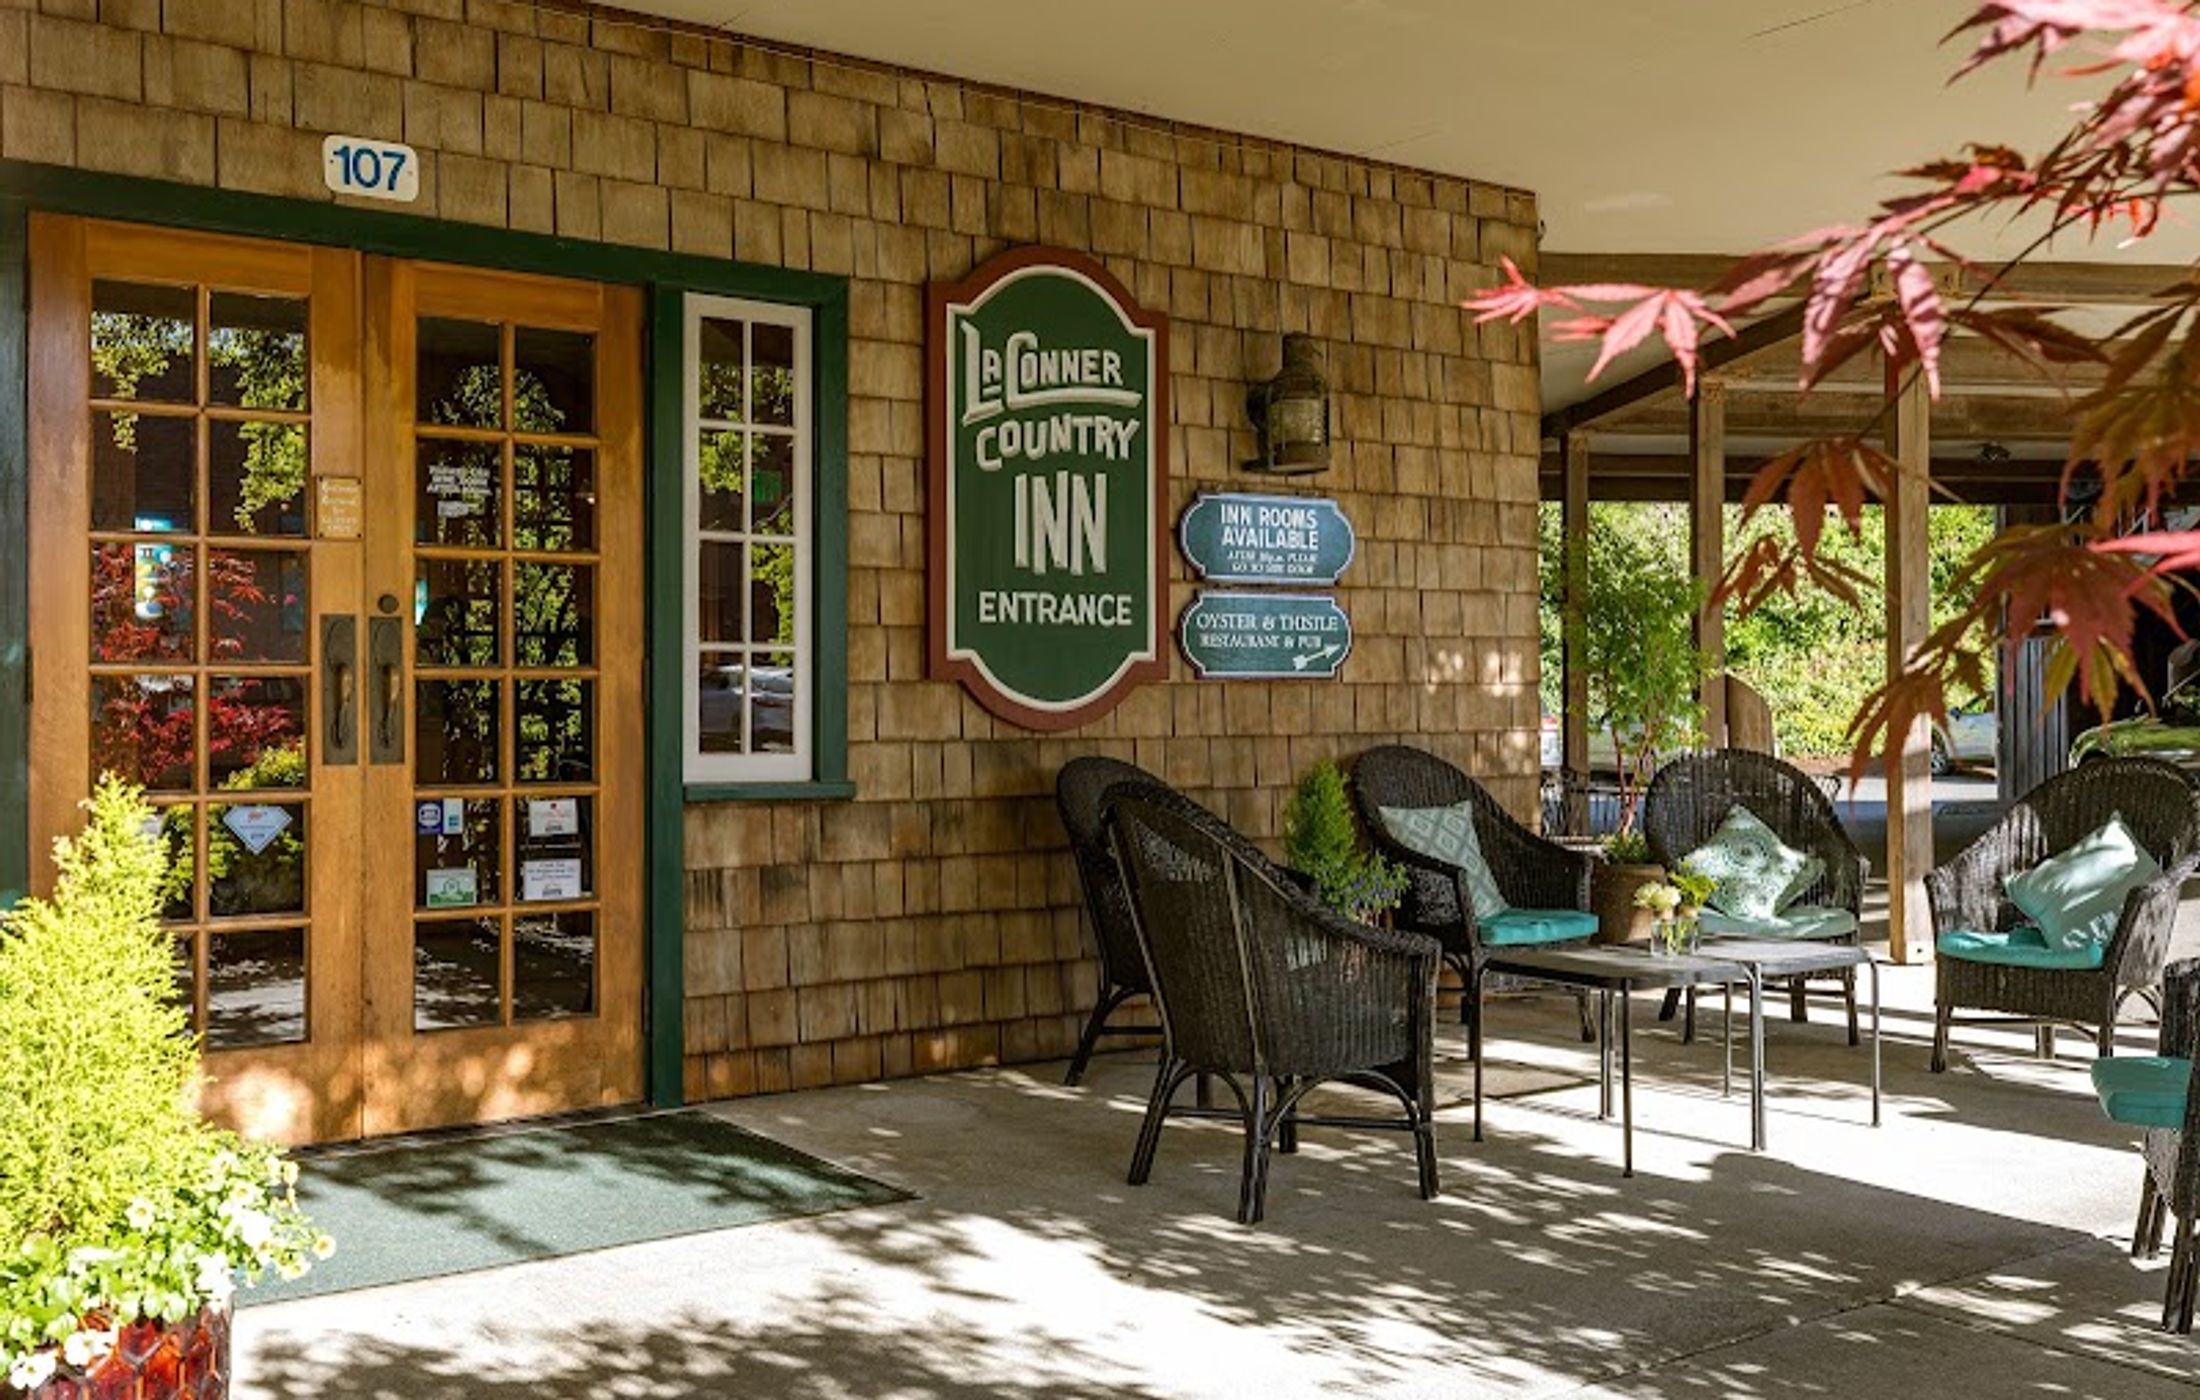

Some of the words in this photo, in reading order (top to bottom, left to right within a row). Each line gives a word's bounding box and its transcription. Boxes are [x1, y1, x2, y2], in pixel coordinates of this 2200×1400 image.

[333, 145, 406, 192] 107
[976, 413, 1141, 472] COUNTRY
[1015, 470, 1108, 576] INN
[1221, 503, 1252, 526] INN
[1259, 506, 1318, 530] ROOMS
[1221, 526, 1320, 552] AVAILABLE
[979, 591, 1133, 627] ENTRANCE
[1196, 613, 1258, 630] OYSTER
[1262, 615, 1276, 632] &
[1279, 613, 1339, 632] THISTLE
[1199, 632, 1281, 649] RESTAURANT
[1297, 634, 1322, 649] PUB
